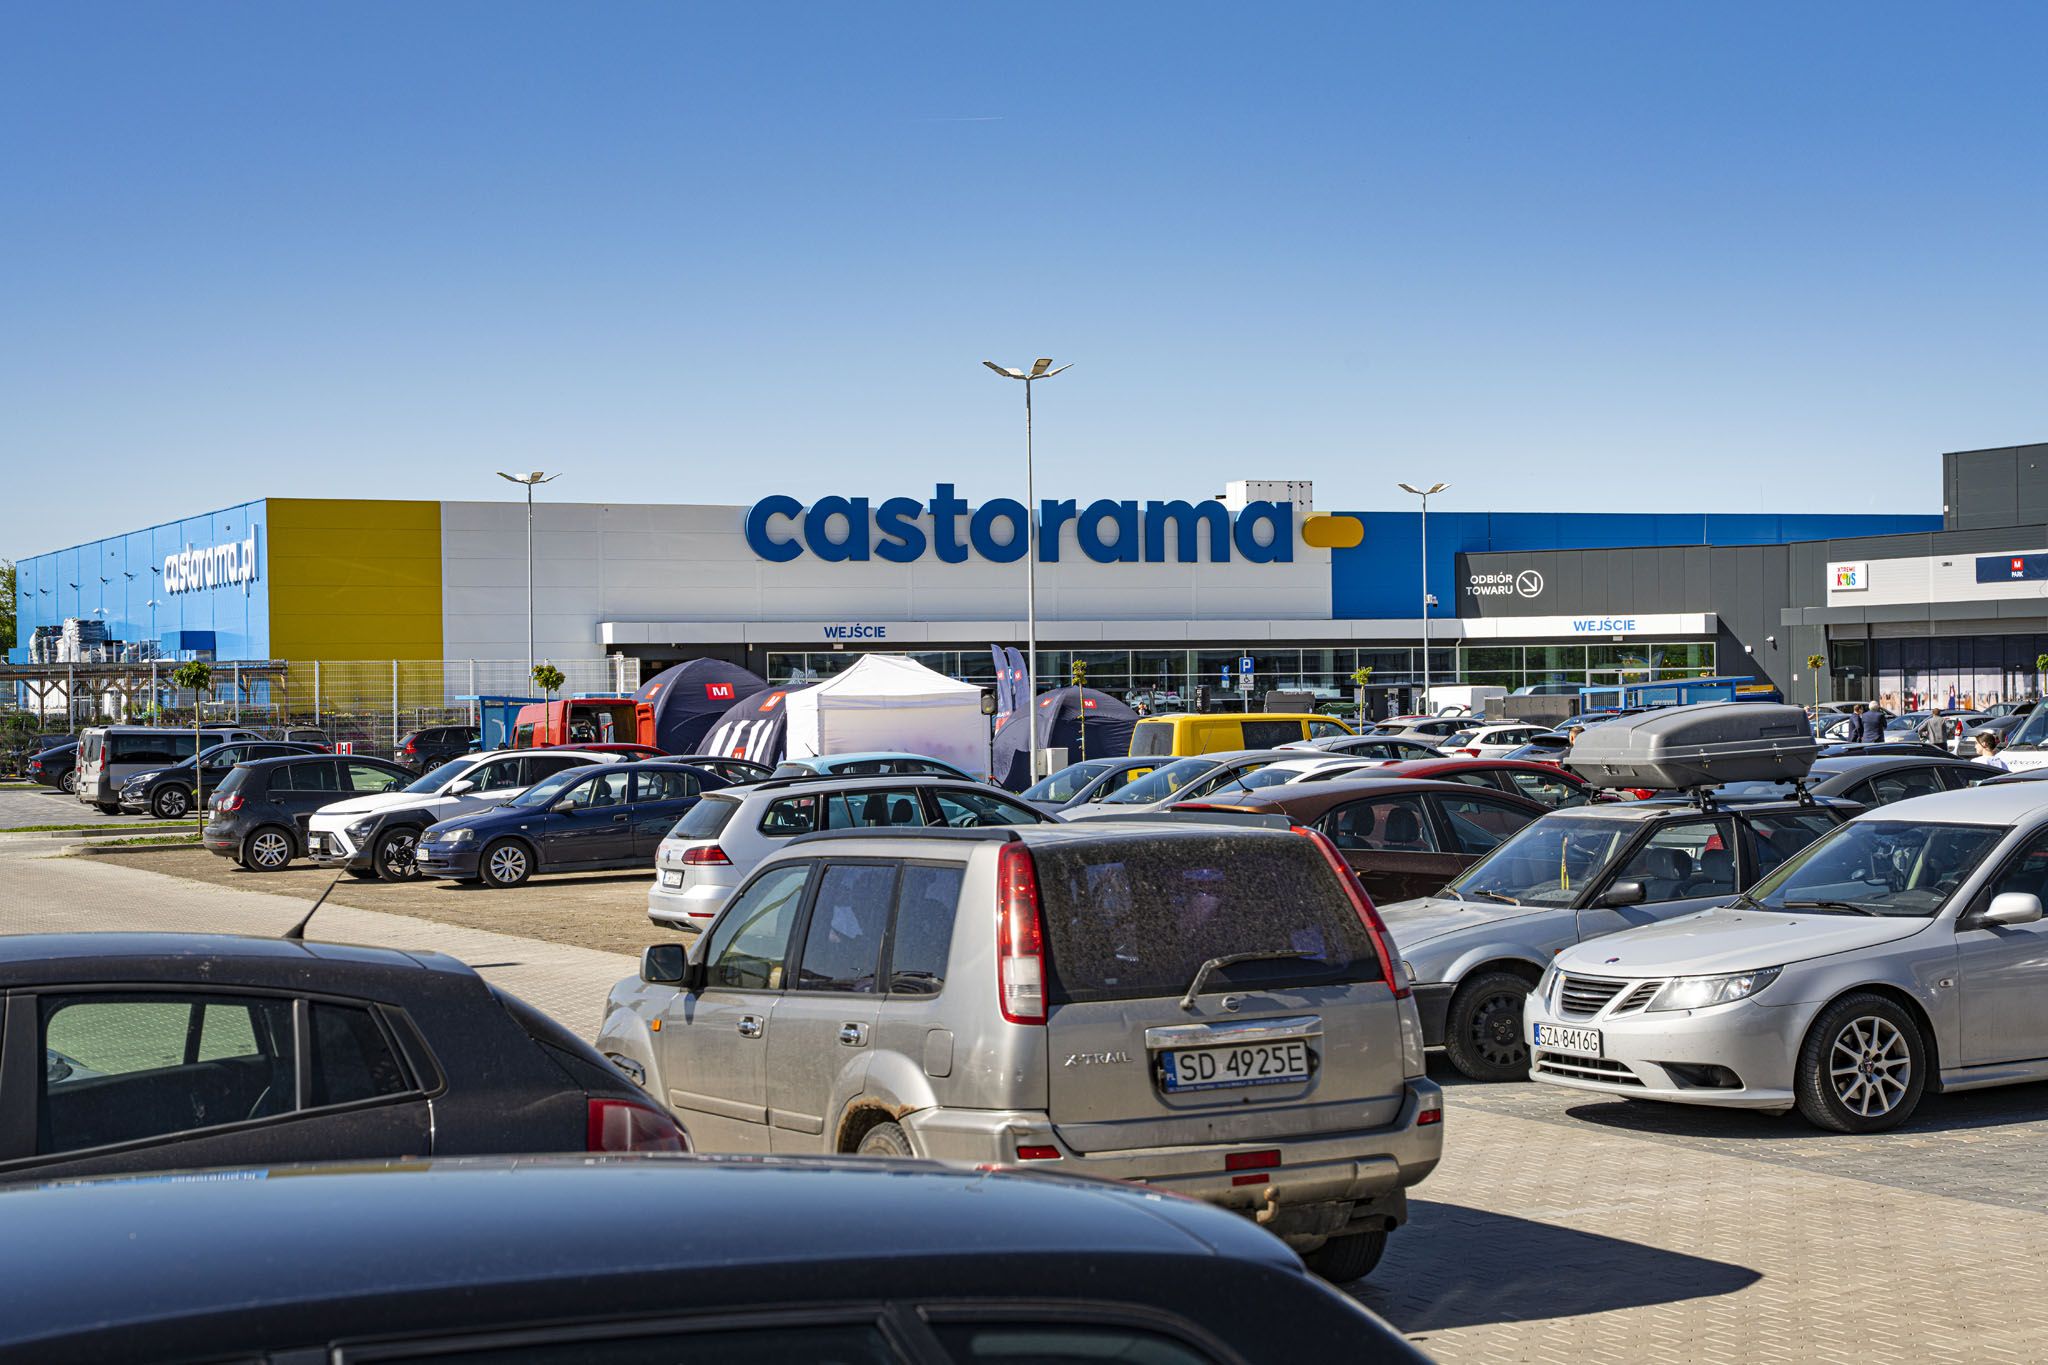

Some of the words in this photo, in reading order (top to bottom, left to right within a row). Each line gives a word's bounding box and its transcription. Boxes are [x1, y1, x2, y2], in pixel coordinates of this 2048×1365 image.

[745, 483, 1294, 564] castorama
[164, 523, 259, 596] castorama.pl
[1470, 571, 1513, 585] ODBIÓR
[2011, 570, 2024, 578] PARK
[1465, 585, 1514, 596] TOWARU
[823, 622, 887, 639] WEJŚCIE
[1573, 616, 1636, 632] WEJŚCIE
[1242, 659, 1252, 673] P
[711, 686, 729, 697] M
[1540, 1026, 1559, 1047] SZA
[1562, 1028, 1598, 1052] 8416G
[1064, 1051, 1134, 1068] X-TRAIL
[1179, 1052, 1216, 1082] SD
[1226, 1044, 1305, 1078] 4925E
